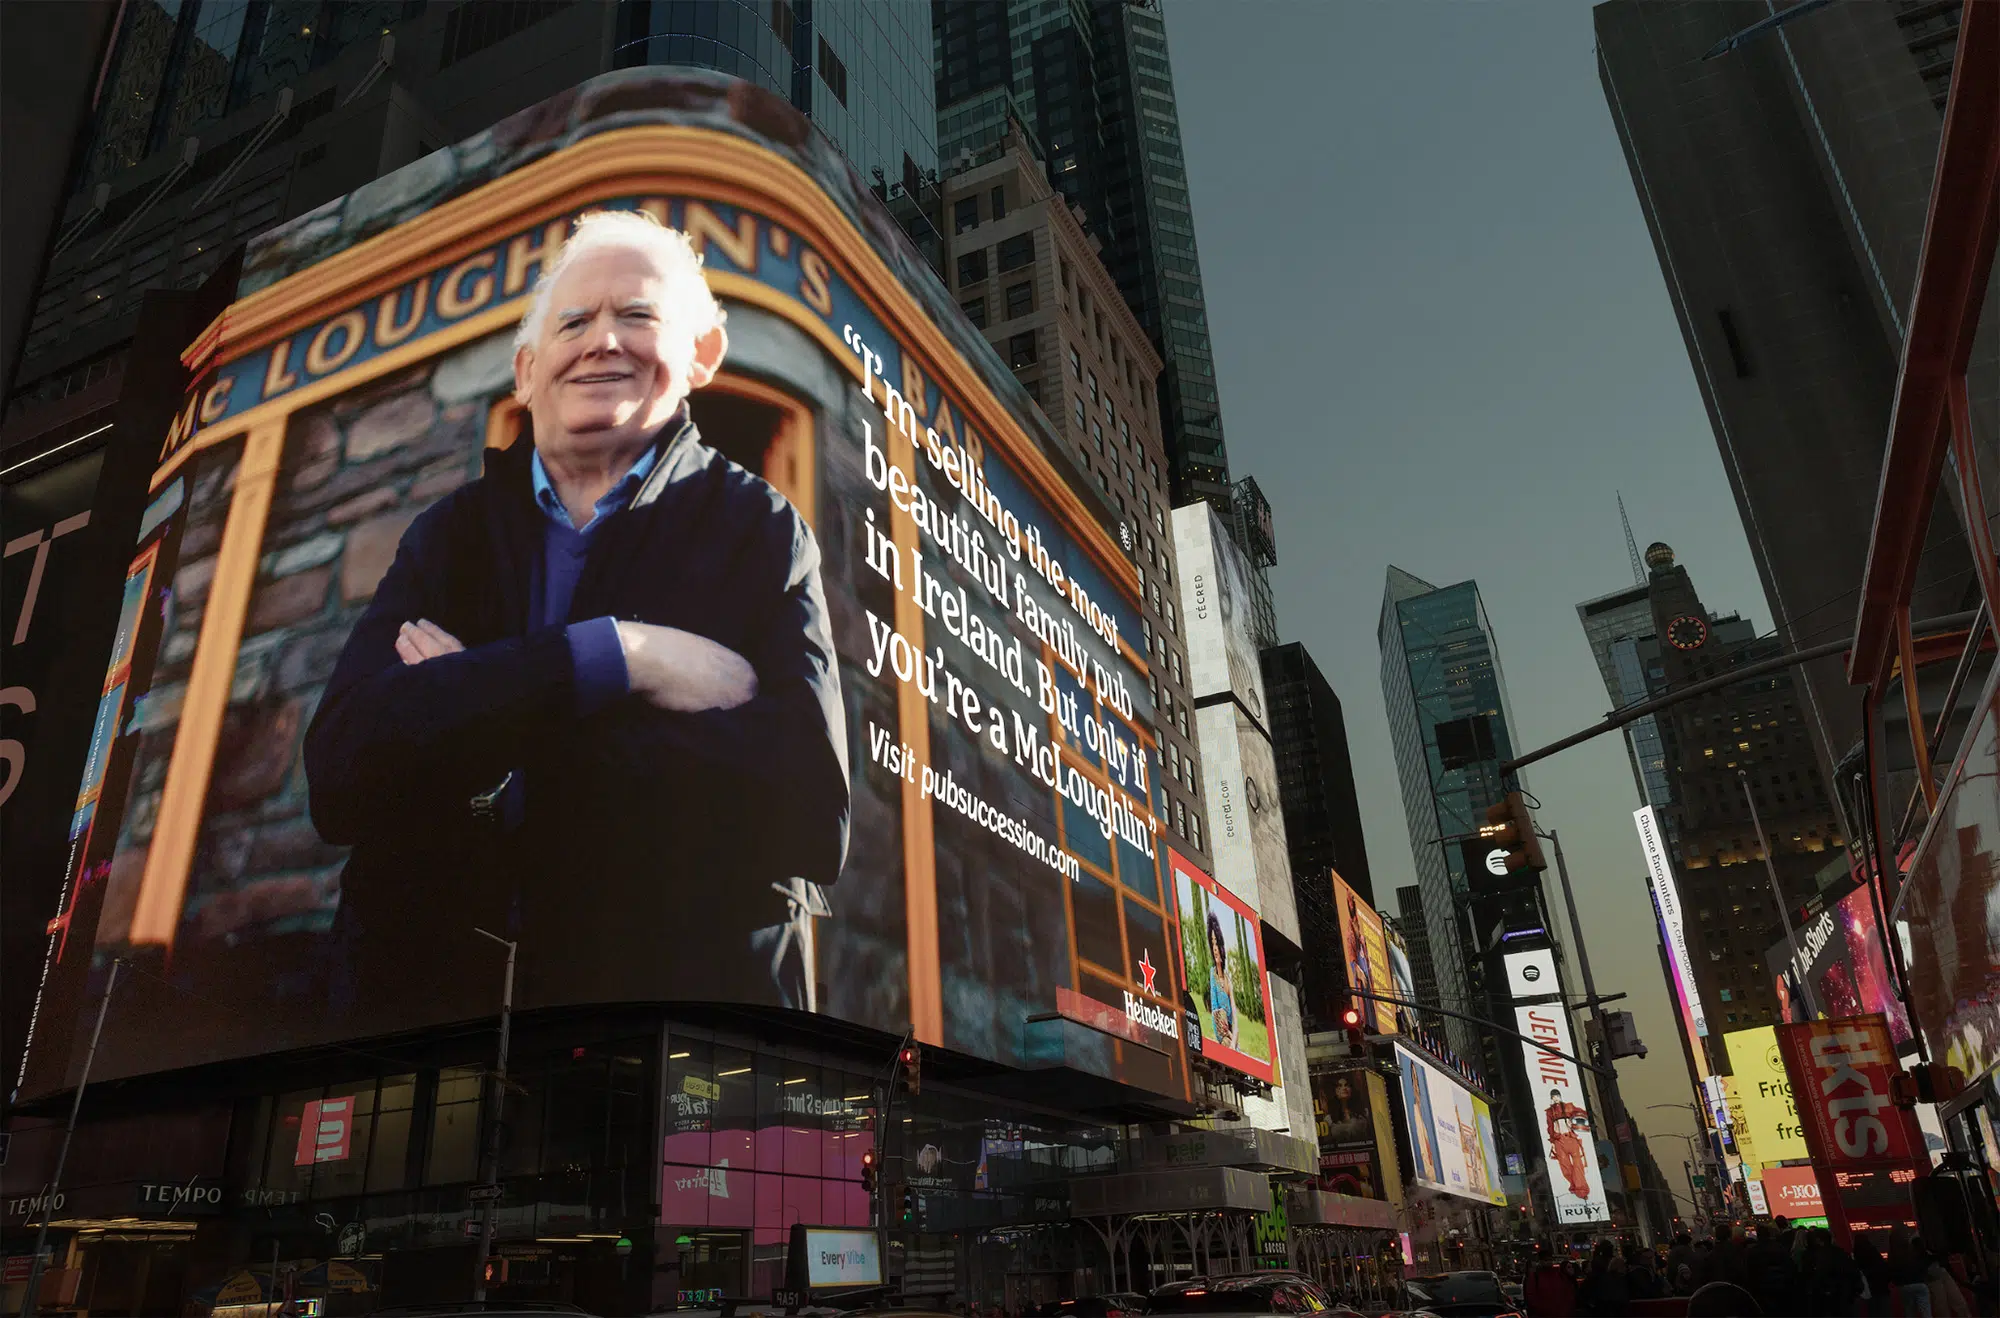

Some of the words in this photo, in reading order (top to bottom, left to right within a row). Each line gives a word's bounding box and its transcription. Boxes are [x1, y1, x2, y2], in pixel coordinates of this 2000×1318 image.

[262, 198, 833, 400] LOUGHN'S
[862, 418, 1011, 610] beautiful
[1014, 572, 1089, 689] family
[1092, 658, 1133, 721] pub
[926, 427, 1021, 562] selling
[1026, 523, 1066, 598] the
[1069, 576, 1121, 655] most
[864, 508, 904, 591] in
[911, 547, 1032, 698] Ireland.
[1036, 658, 1081, 737] But
[1084, 717, 1129, 785] only
[1133, 748, 1147, 794] if
[866, 609, 982, 733] you’re
[990, 707, 1009, 755] a
[869, 721, 915, 784] Visit
[921, 762, 1080, 883] pubsuccession.com
[1221, 779, 1234, 839] cecred.com
[1640, 813, 1656, 853] Chance
[1652, 853, 1675, 916] Encounters
[1675, 929, 1684, 948] CNN
[1805, 911, 1835, 959] Shorts
[1123, 990, 1179, 1040] Heineken
[1528, 1010, 1569, 1088] JENNIE
[1809, 1025, 1891, 1158] tkts
[142, 1184, 222, 1204] TEMPO
[1565, 1206, 1600, 1216] RUBY
[821, 1252, 845, 1270] Every
[846, 1251, 865, 1265] Vibe
[1264, 1242, 1287, 1254] SOCCER
